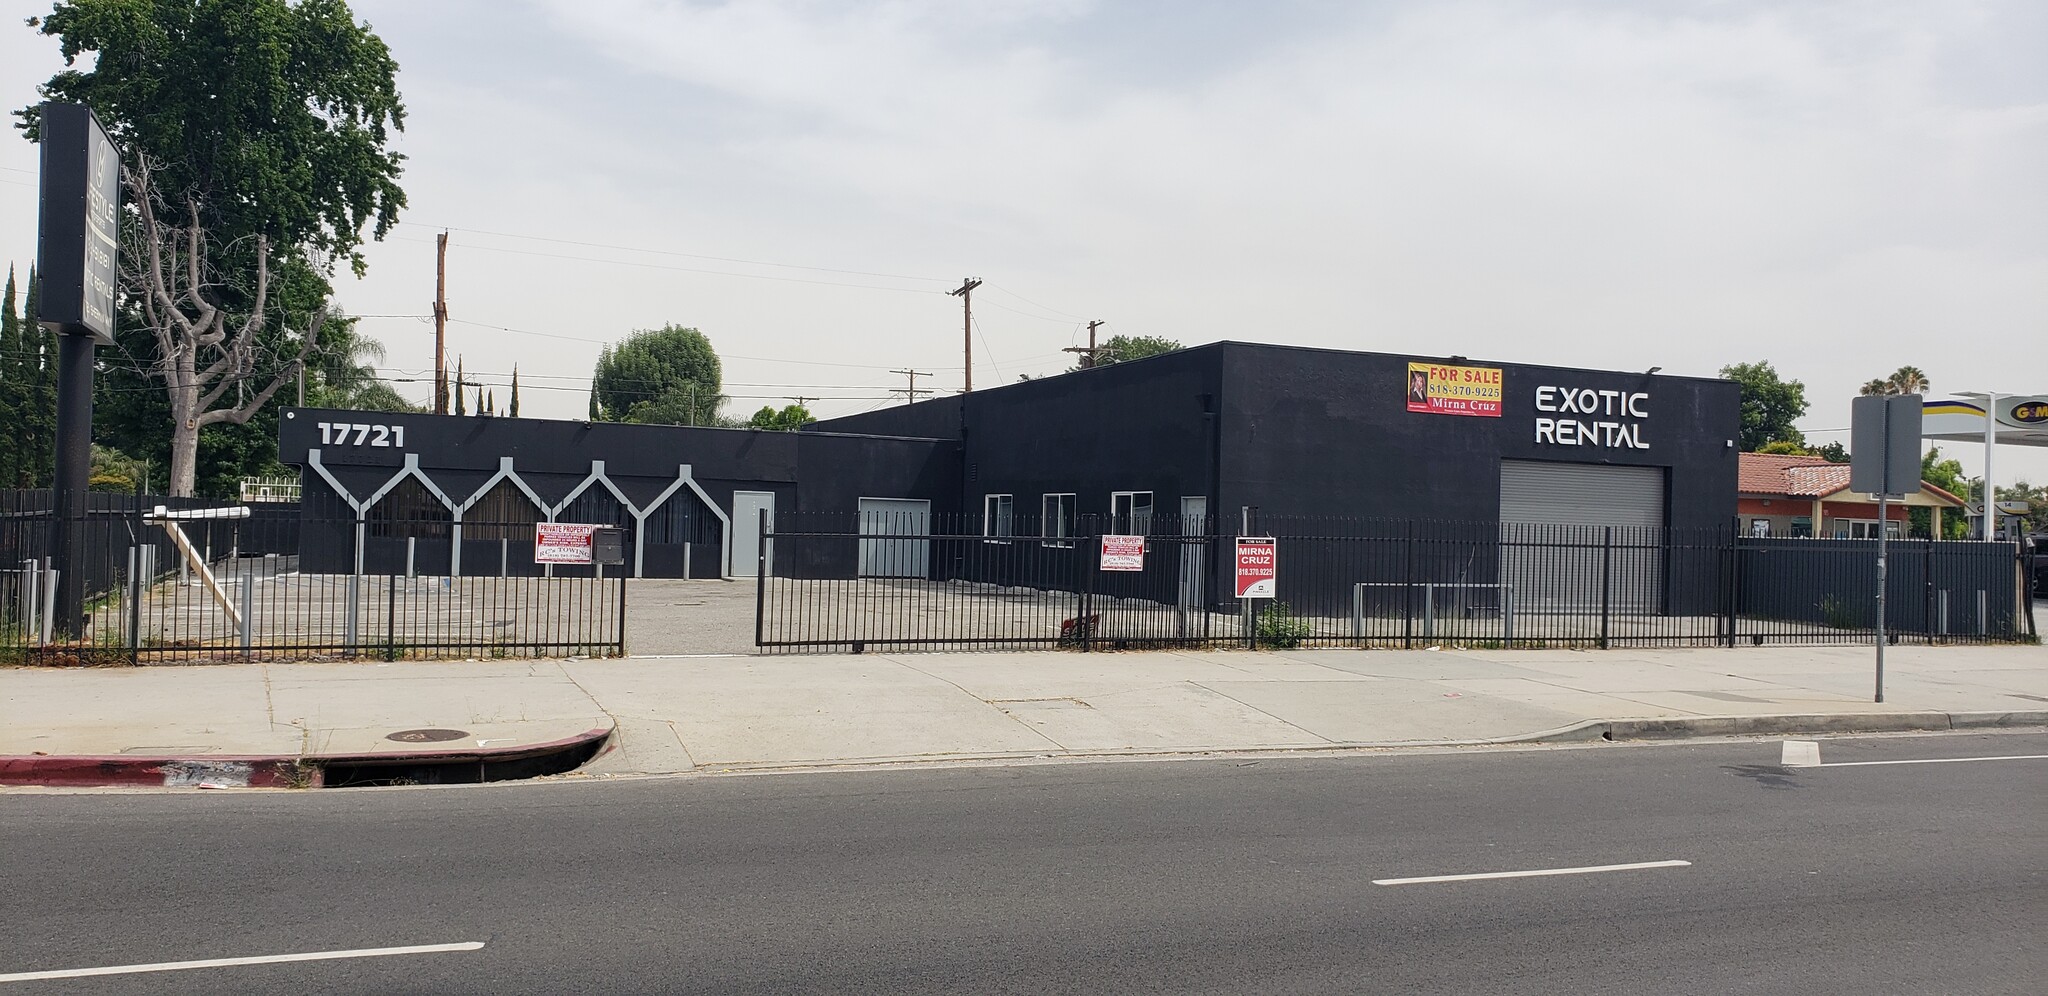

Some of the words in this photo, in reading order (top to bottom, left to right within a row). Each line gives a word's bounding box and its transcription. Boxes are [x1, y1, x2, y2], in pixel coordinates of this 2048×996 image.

[1430, 367, 1458, 381] FOR
[1464, 370, 1499, 384] SALE
[1429, 384, 1500, 398] 818-370-9225
[1432, 397, 1466, 409] Mirna
[1470, 400, 1496, 411] Cruz
[1535, 385, 1649, 418] EXOTIC
[317, 422, 404, 447] 17721
[1535, 417, 1650, 449] RENTAL
[563, 525, 591, 533] PROPERTY
[1238, 547, 1273, 555] MIRNA
[1241, 556, 1271, 564] CRUZ
[1238, 568, 1273, 576] 818.370.9225
